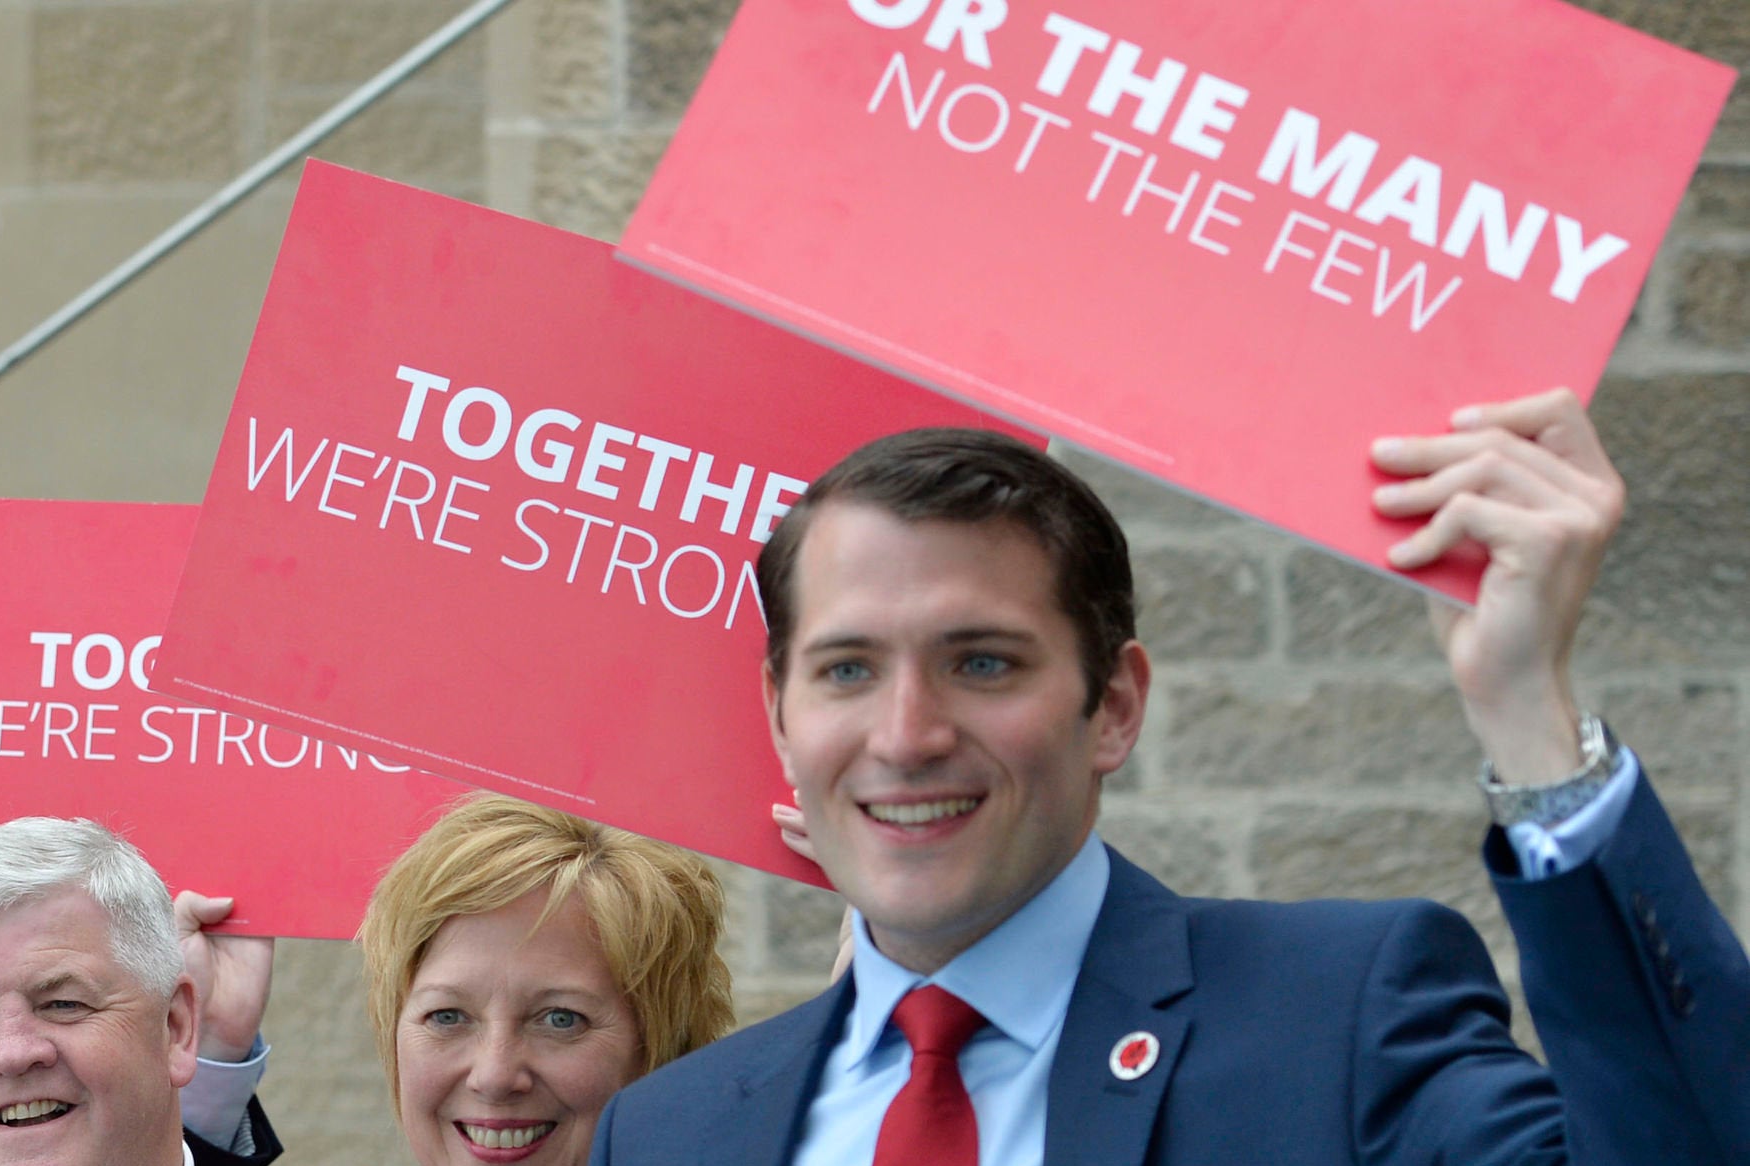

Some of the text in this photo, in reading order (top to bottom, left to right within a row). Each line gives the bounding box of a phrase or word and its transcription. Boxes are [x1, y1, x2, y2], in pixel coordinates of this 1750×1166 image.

[867, 51, 1463, 333] NOT THE FEW
[1036, 12, 1249, 160] THE
[1257, 107, 1629, 303] MANY
[246, 416, 770, 636] WE'RE STRON
[395, 364, 810, 545] TOGETHE
